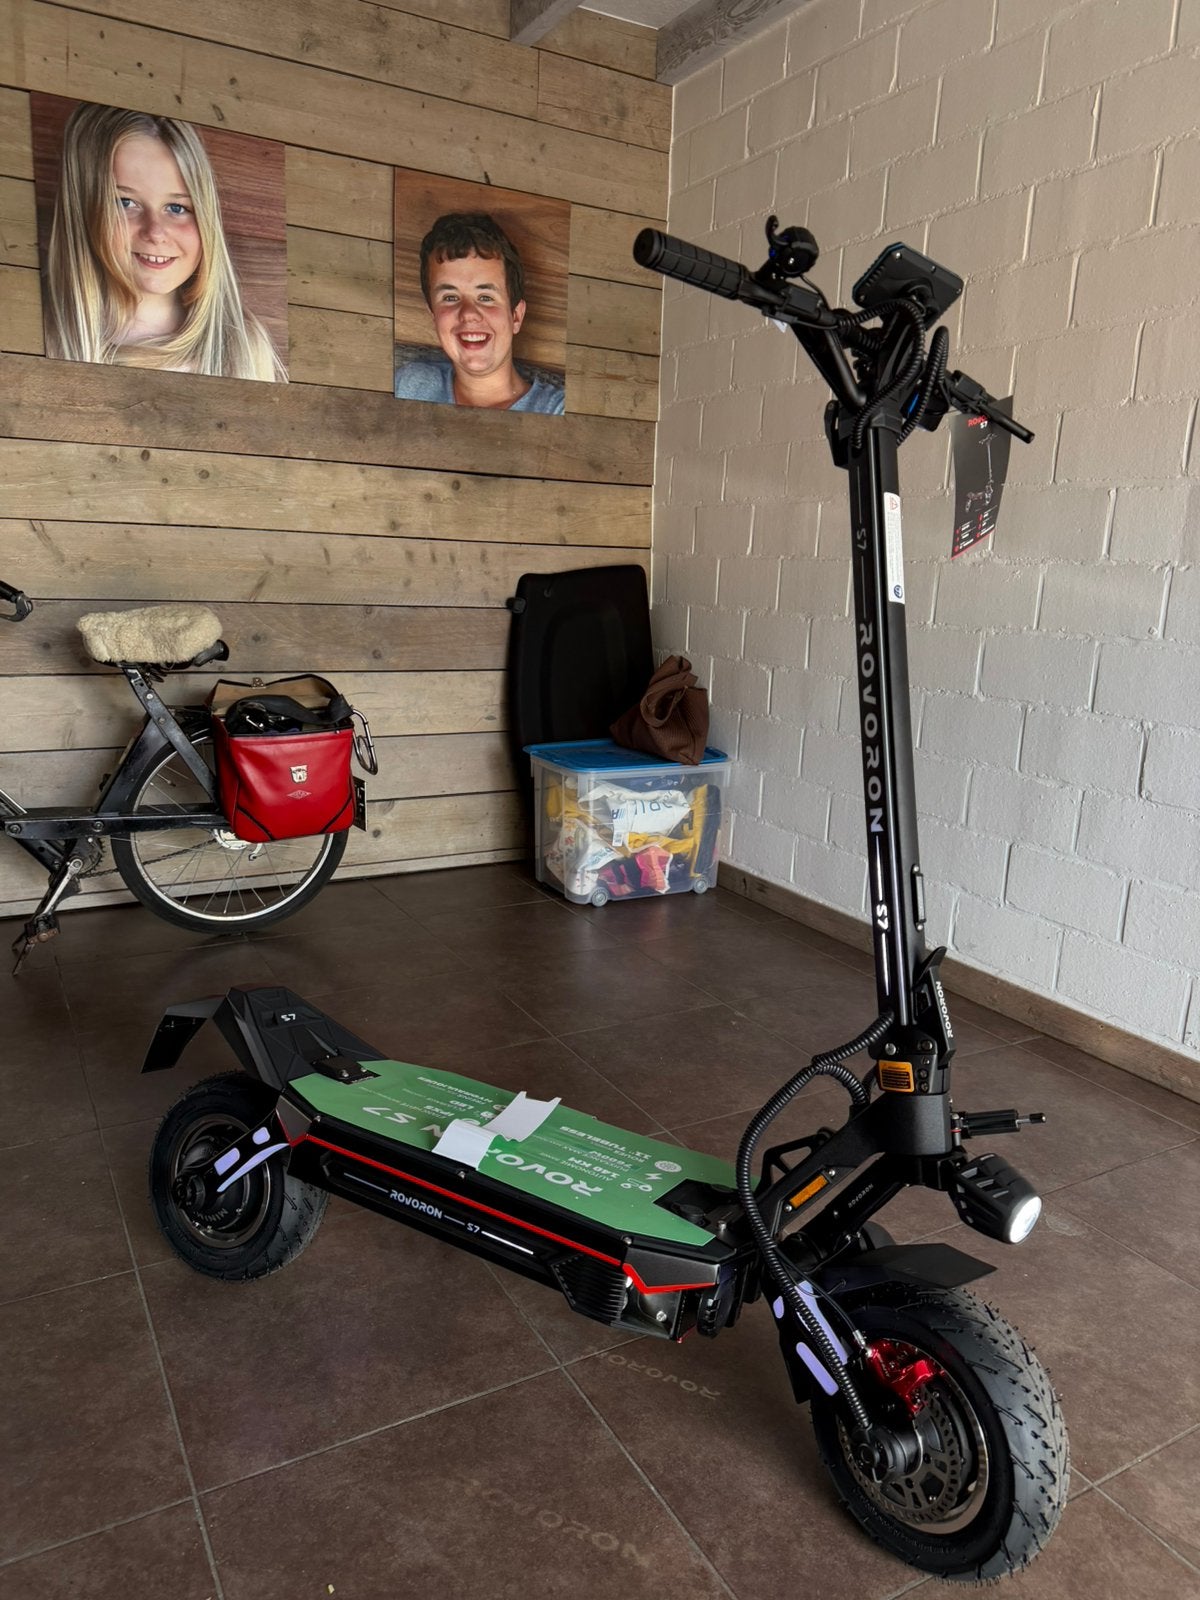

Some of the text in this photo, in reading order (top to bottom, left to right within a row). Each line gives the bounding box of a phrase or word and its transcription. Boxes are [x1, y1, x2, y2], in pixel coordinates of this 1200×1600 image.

[856, 528, 867, 550] S7
[860, 622, 884, 833] ROVORON
[876, 903, 889, 931] S7
[280, 1013, 296, 1022] S7
[935, 981, 954, 1038] ROVORON
[362, 1107, 417, 1124] S7
[567, 1157, 592, 1168] KM
[390, 1190, 480, 1234] ROVORON S7
